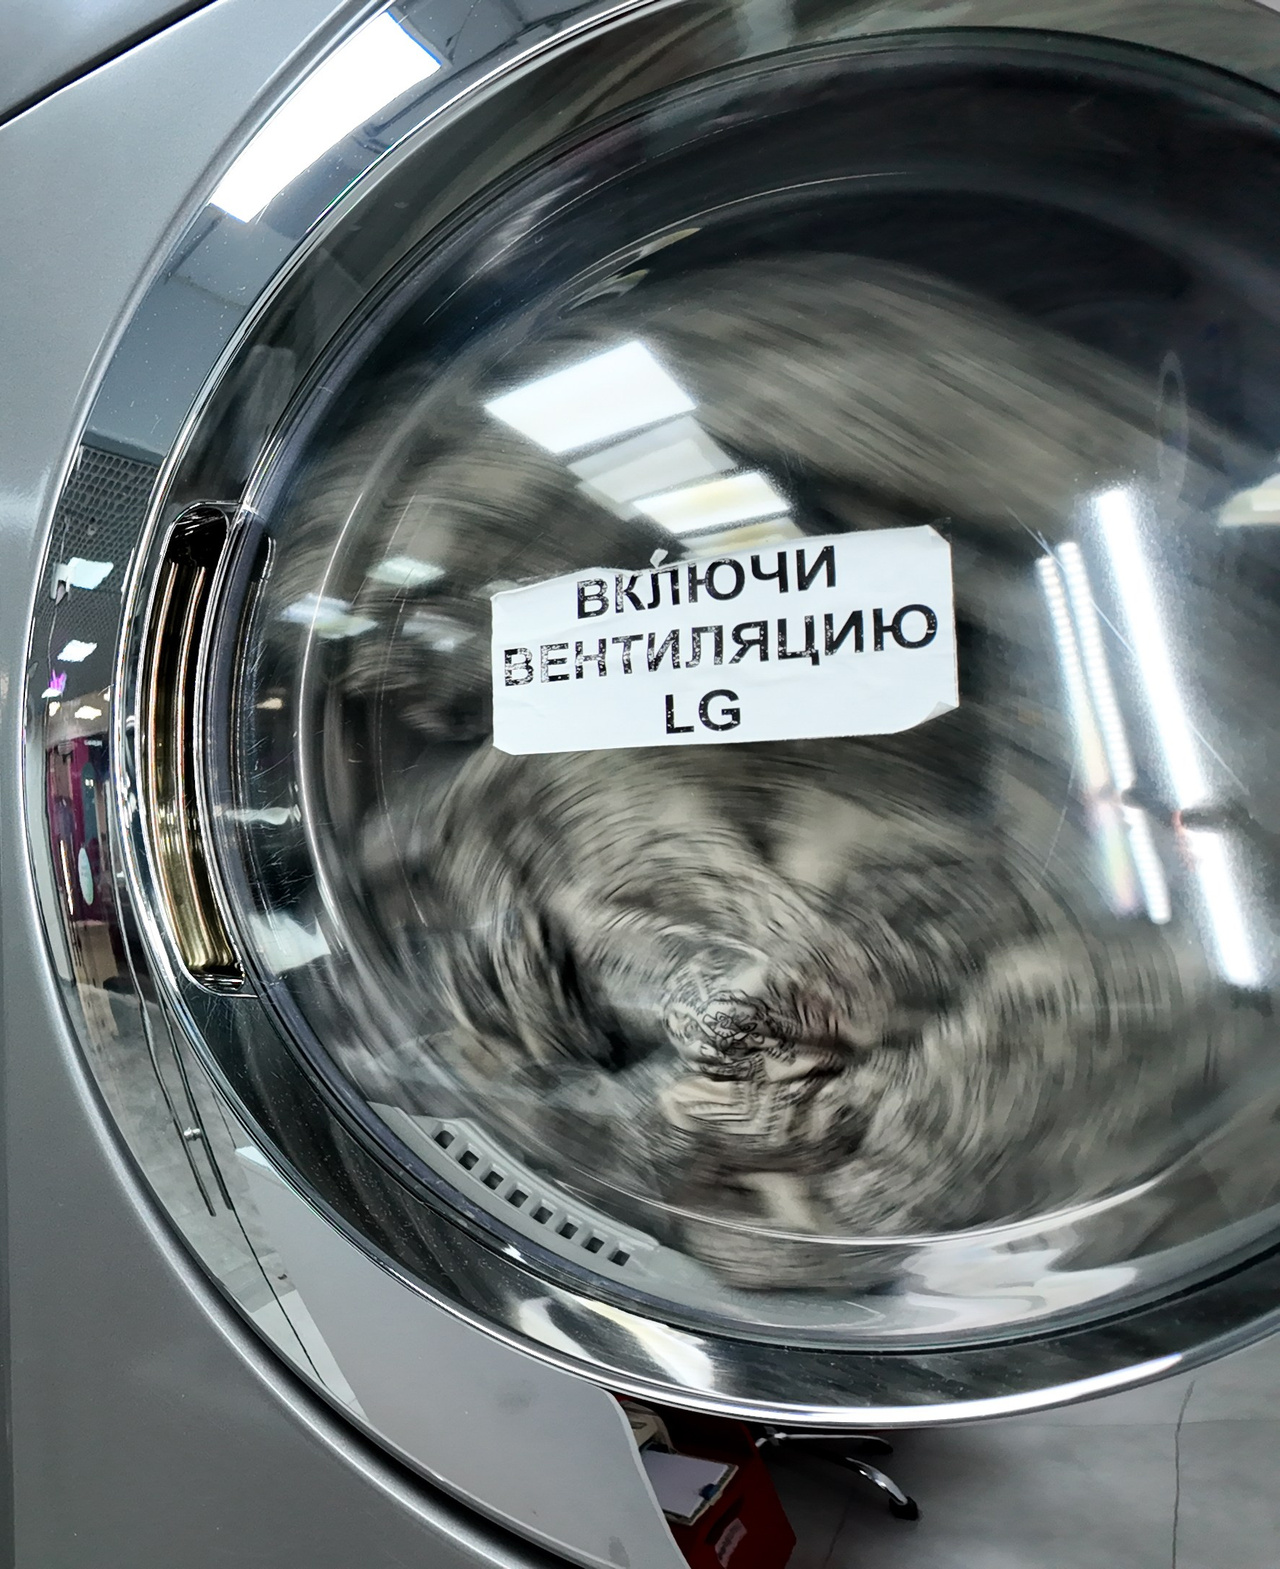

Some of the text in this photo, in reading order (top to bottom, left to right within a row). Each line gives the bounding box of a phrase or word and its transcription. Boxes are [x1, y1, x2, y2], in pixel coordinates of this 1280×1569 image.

[576, 545, 836, 620] ВКЛЮЧИ
[503, 603, 938, 687] ВЕНТИЛЯЦИЮ
[665, 688, 742, 735] LG
